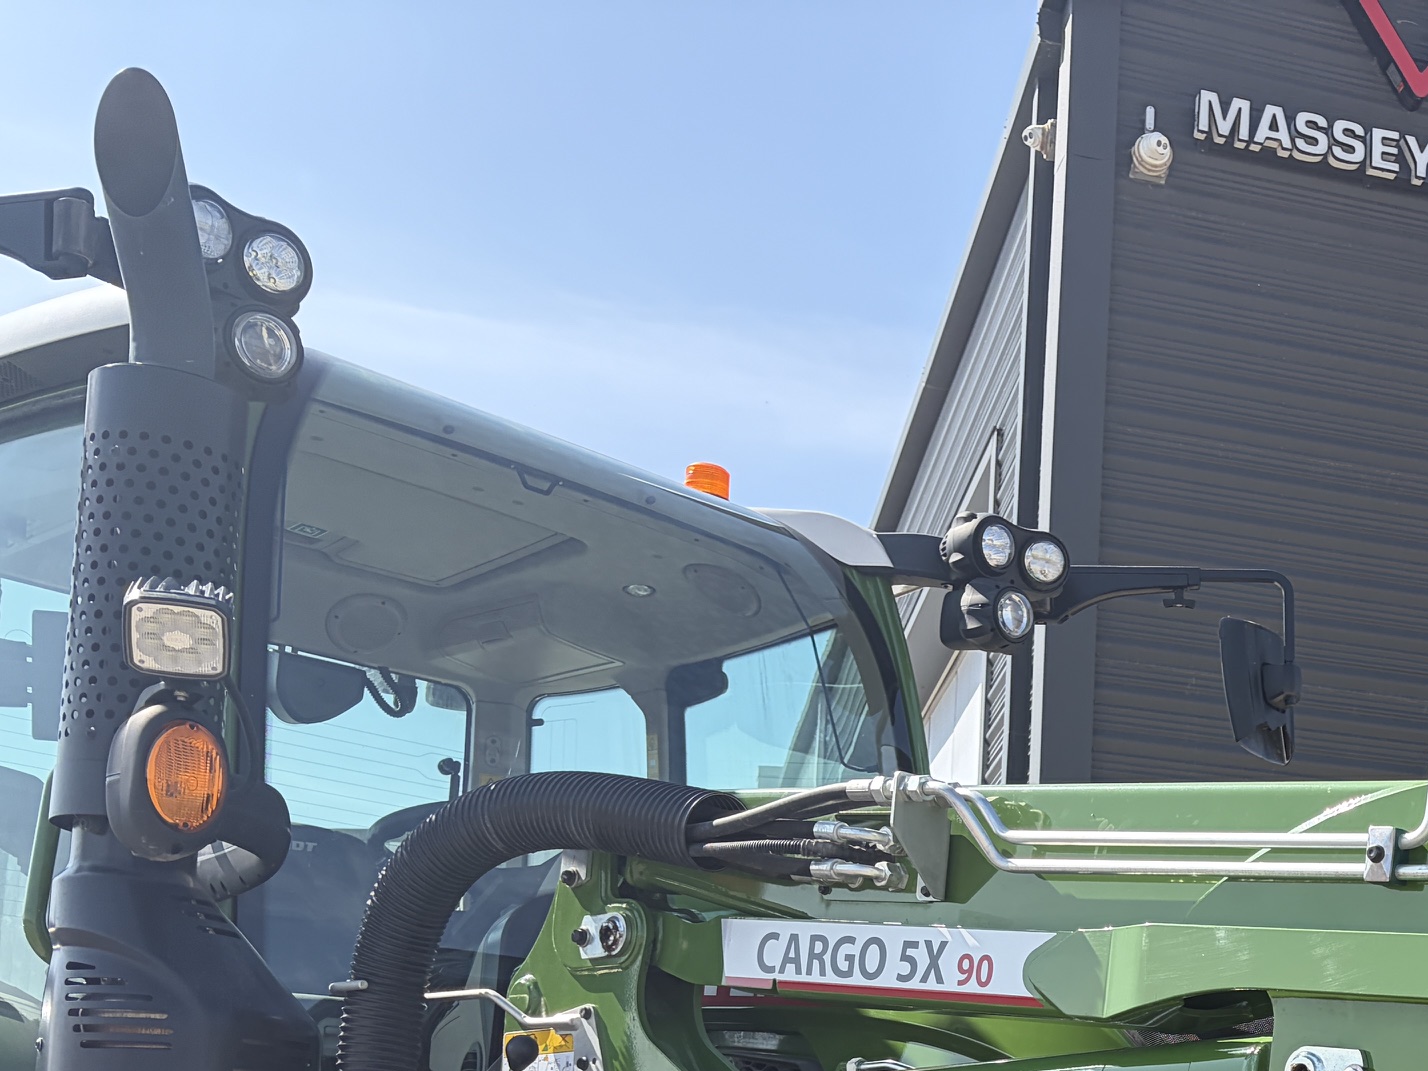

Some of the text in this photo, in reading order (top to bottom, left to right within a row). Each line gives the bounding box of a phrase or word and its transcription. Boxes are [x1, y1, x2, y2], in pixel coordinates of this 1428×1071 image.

[290, 840, 317, 852] DT
[757, 932, 994, 988] CARGO 5X 90
